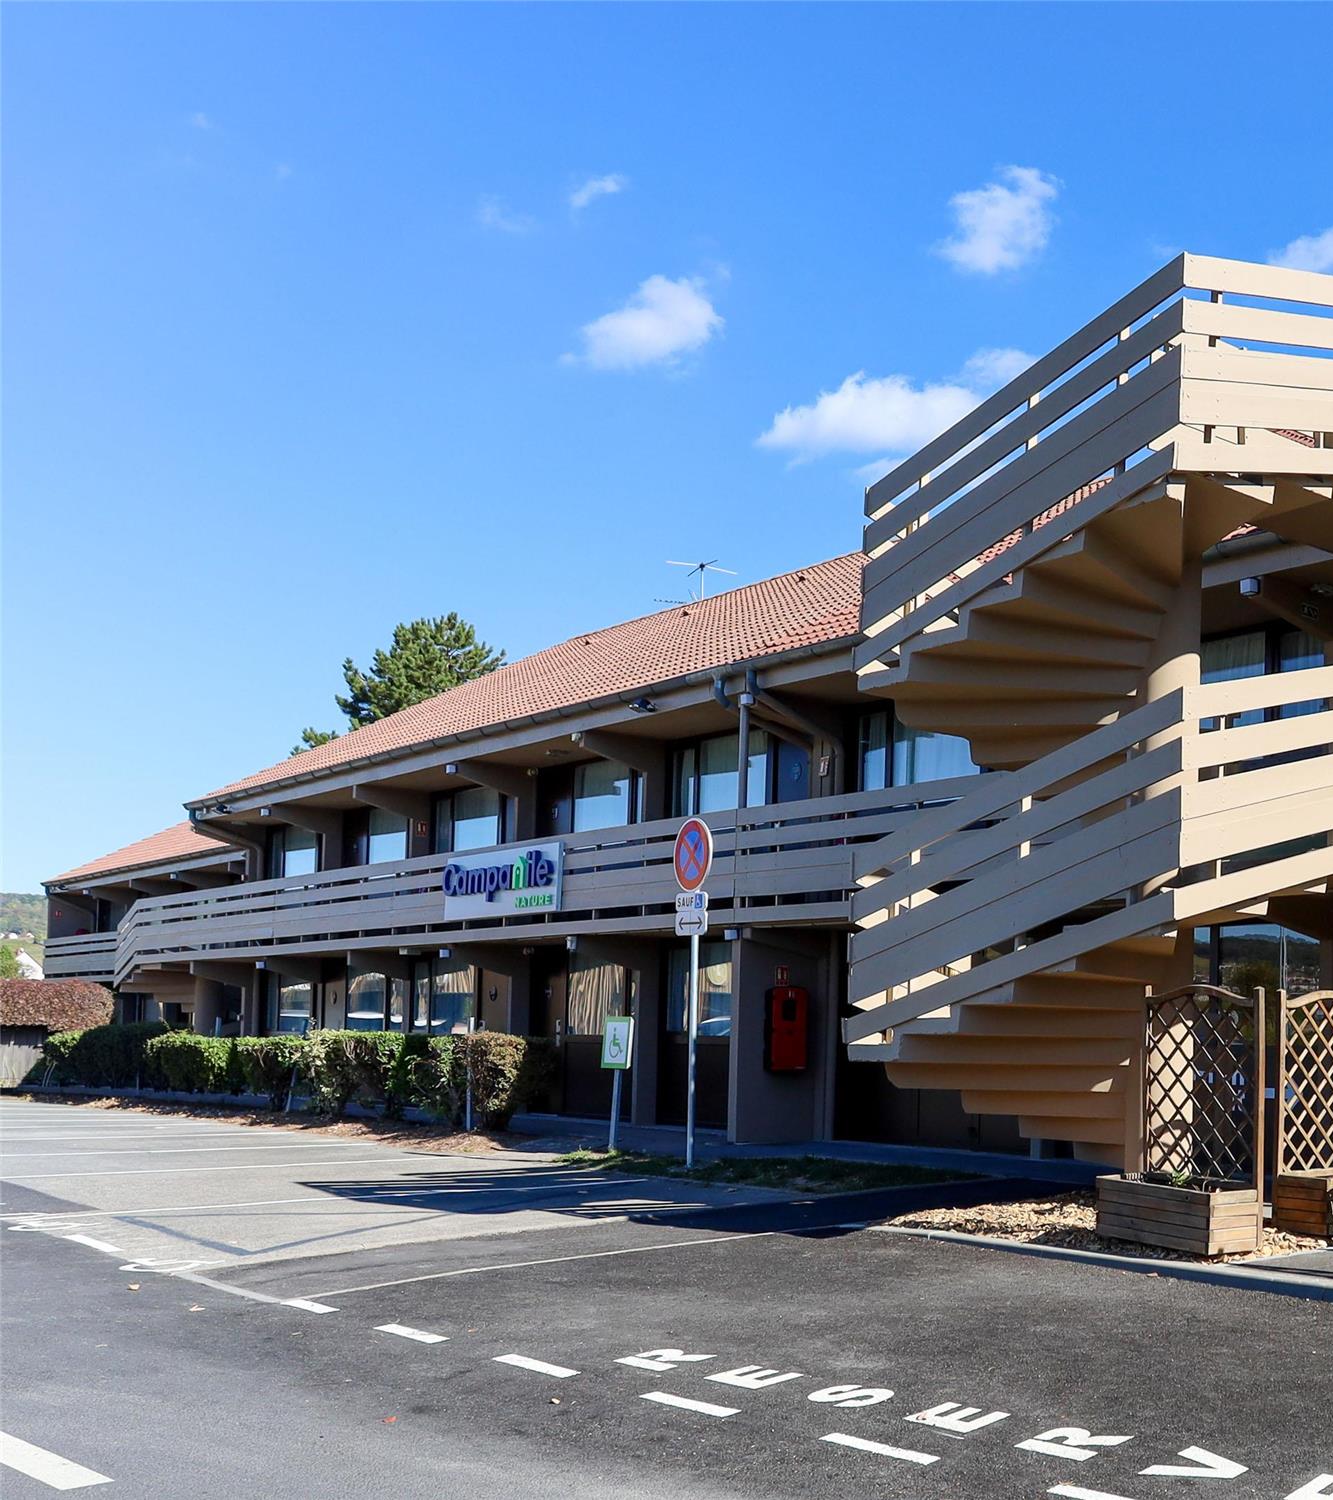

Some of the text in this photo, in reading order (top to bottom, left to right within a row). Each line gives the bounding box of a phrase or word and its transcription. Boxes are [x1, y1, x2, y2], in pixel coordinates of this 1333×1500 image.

[442, 850, 554, 902] Campanile
[514, 895, 552, 908] NATURE
[677, 896, 694, 907] SAUF
